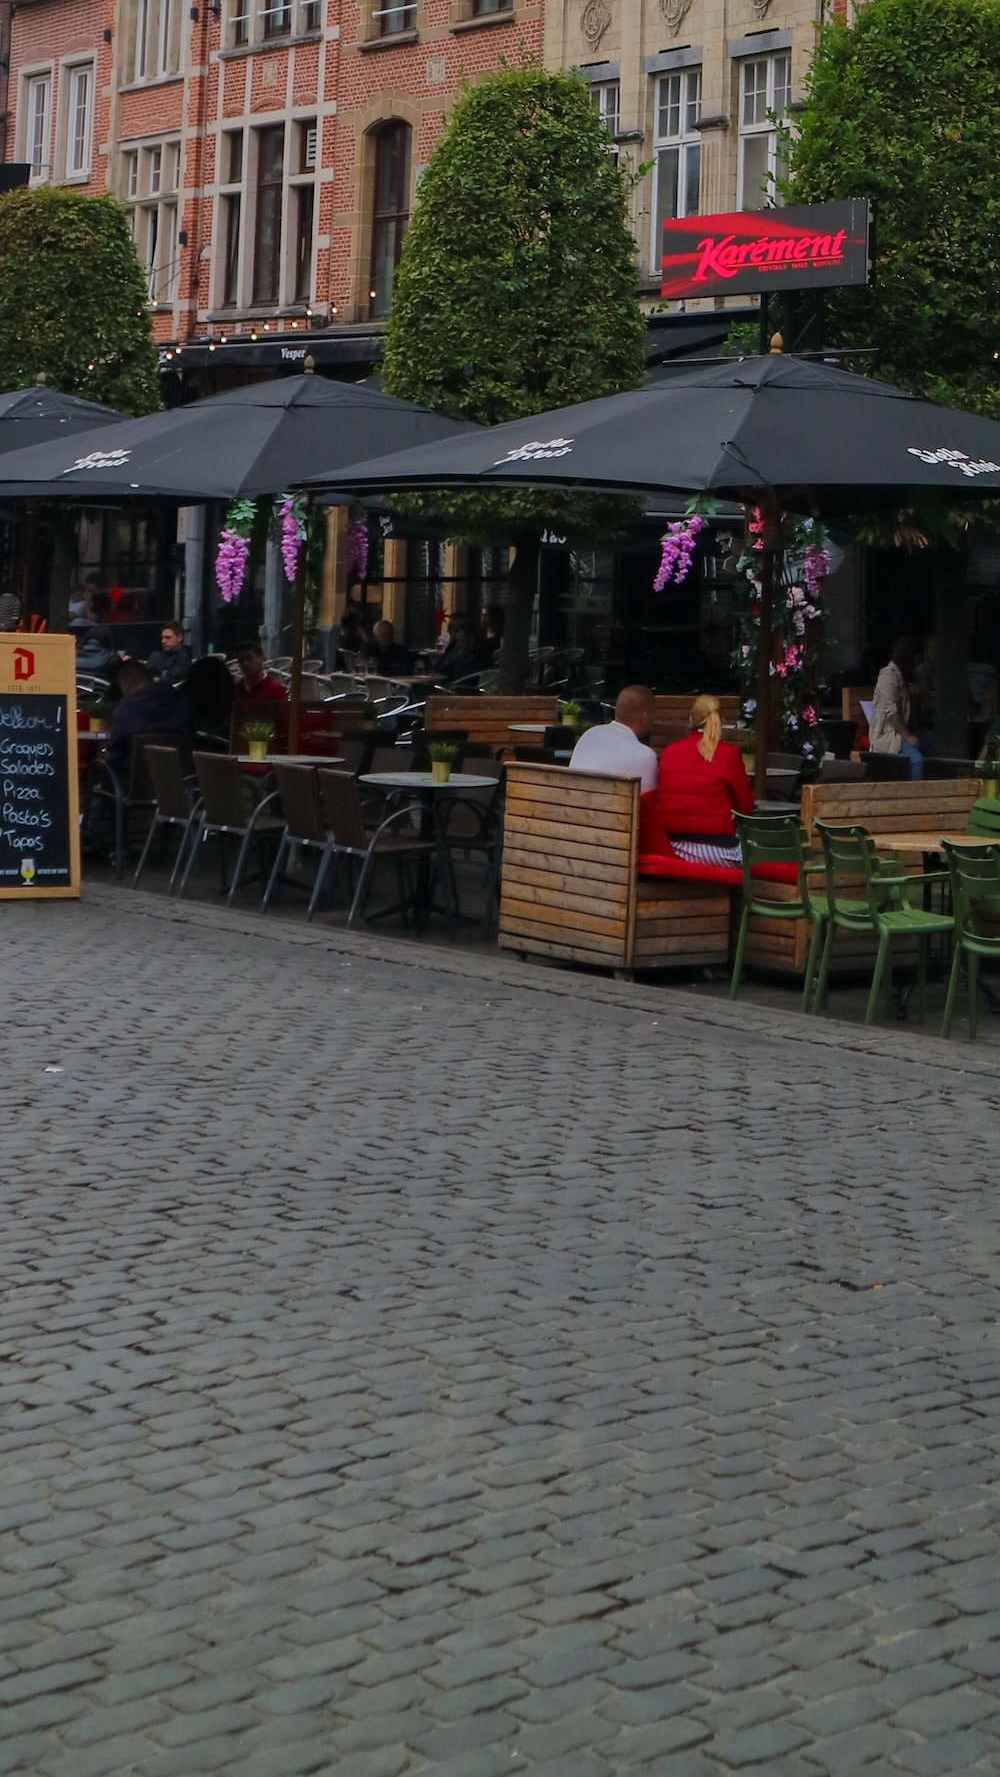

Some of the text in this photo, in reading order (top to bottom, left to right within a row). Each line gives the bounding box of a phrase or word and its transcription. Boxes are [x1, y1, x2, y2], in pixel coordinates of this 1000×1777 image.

[691, 229, 847, 281] Karément
[281, 348, 306, 360] Vesper
[906, 447, 970, 464] Stella
[0, 738, 54, 760] Croques
[0, 758, 55, 776] Salades
[3, 779, 44, 800] Pizza
[2, 802, 52, 828] Pasta's
[3, 829, 44, 852] Tapas
